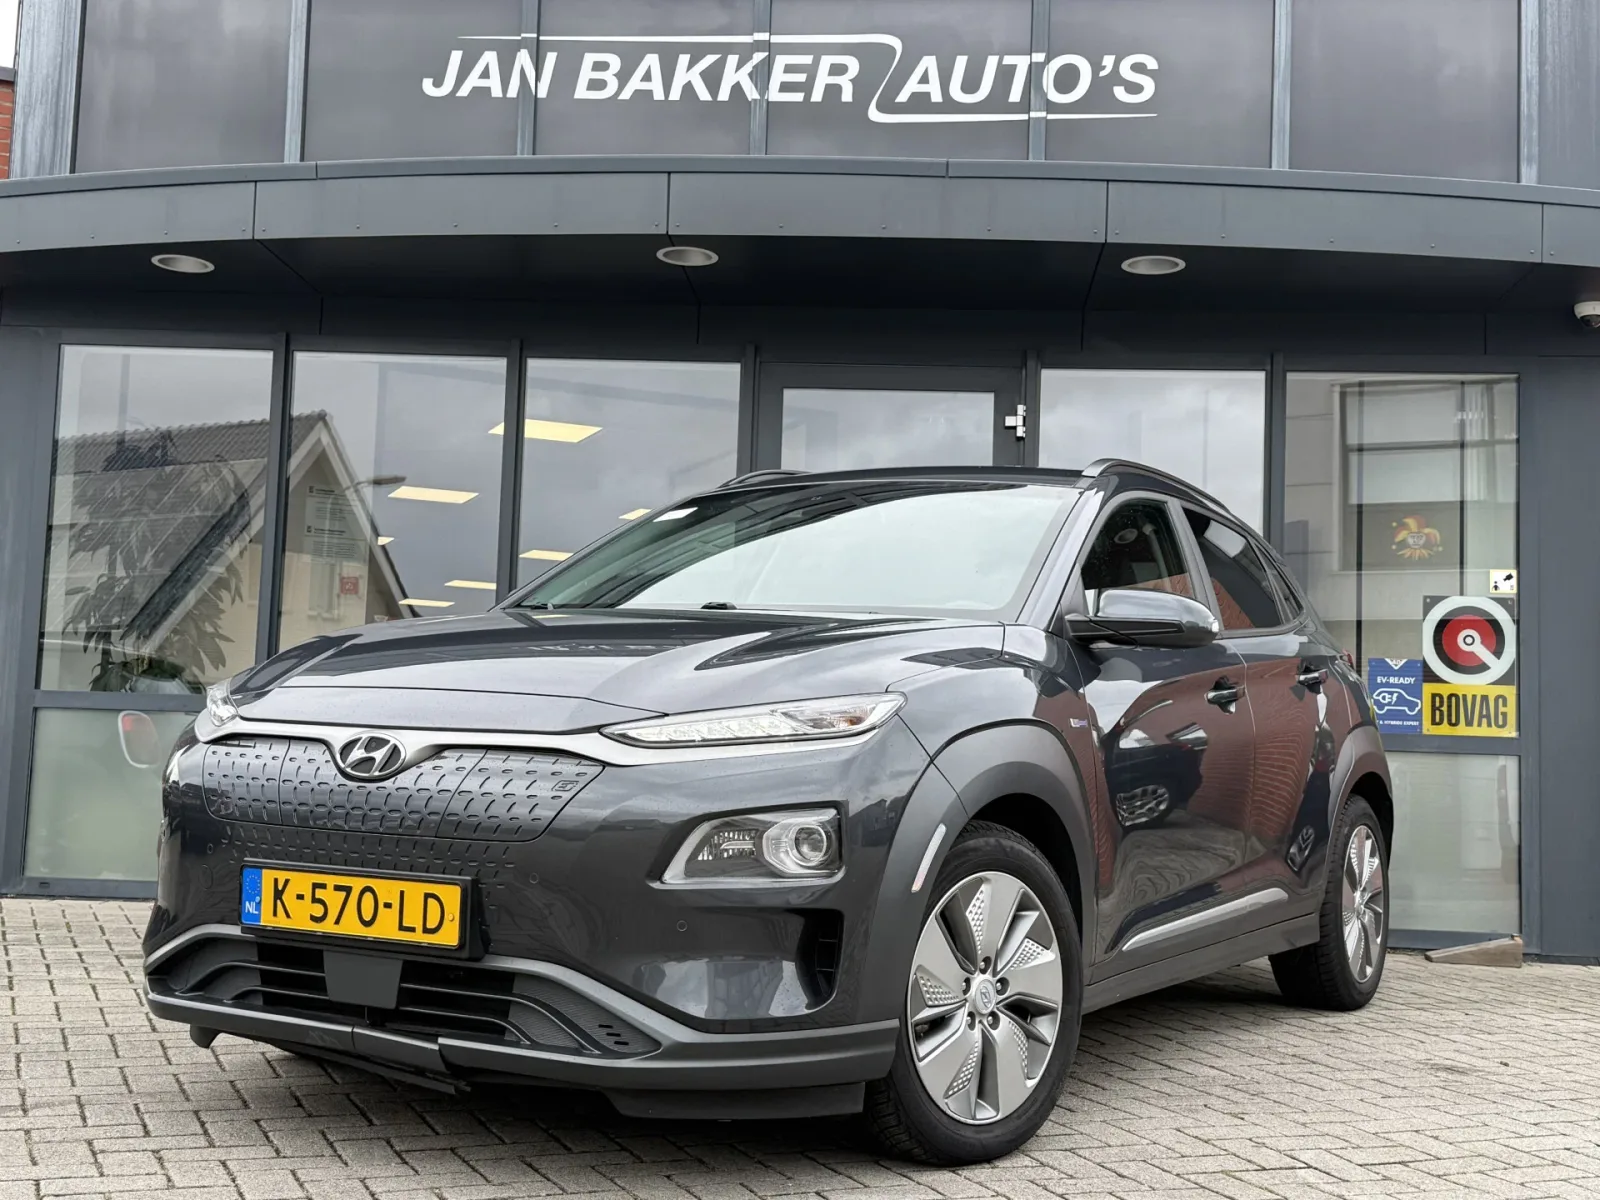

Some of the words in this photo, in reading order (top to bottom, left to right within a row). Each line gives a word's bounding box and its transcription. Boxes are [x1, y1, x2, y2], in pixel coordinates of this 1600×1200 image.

[421, 49, 558, 99] JAN
[573, 52, 860, 104] BAKKER
[895, 53, 1159, 105] AUTO'S
[1376, 676, 1416, 685] EV-READY
[1430, 692, 1508, 729] BOVAG
[245, 901, 259, 914] NL
[272, 877, 446, 934] K-570-LD
